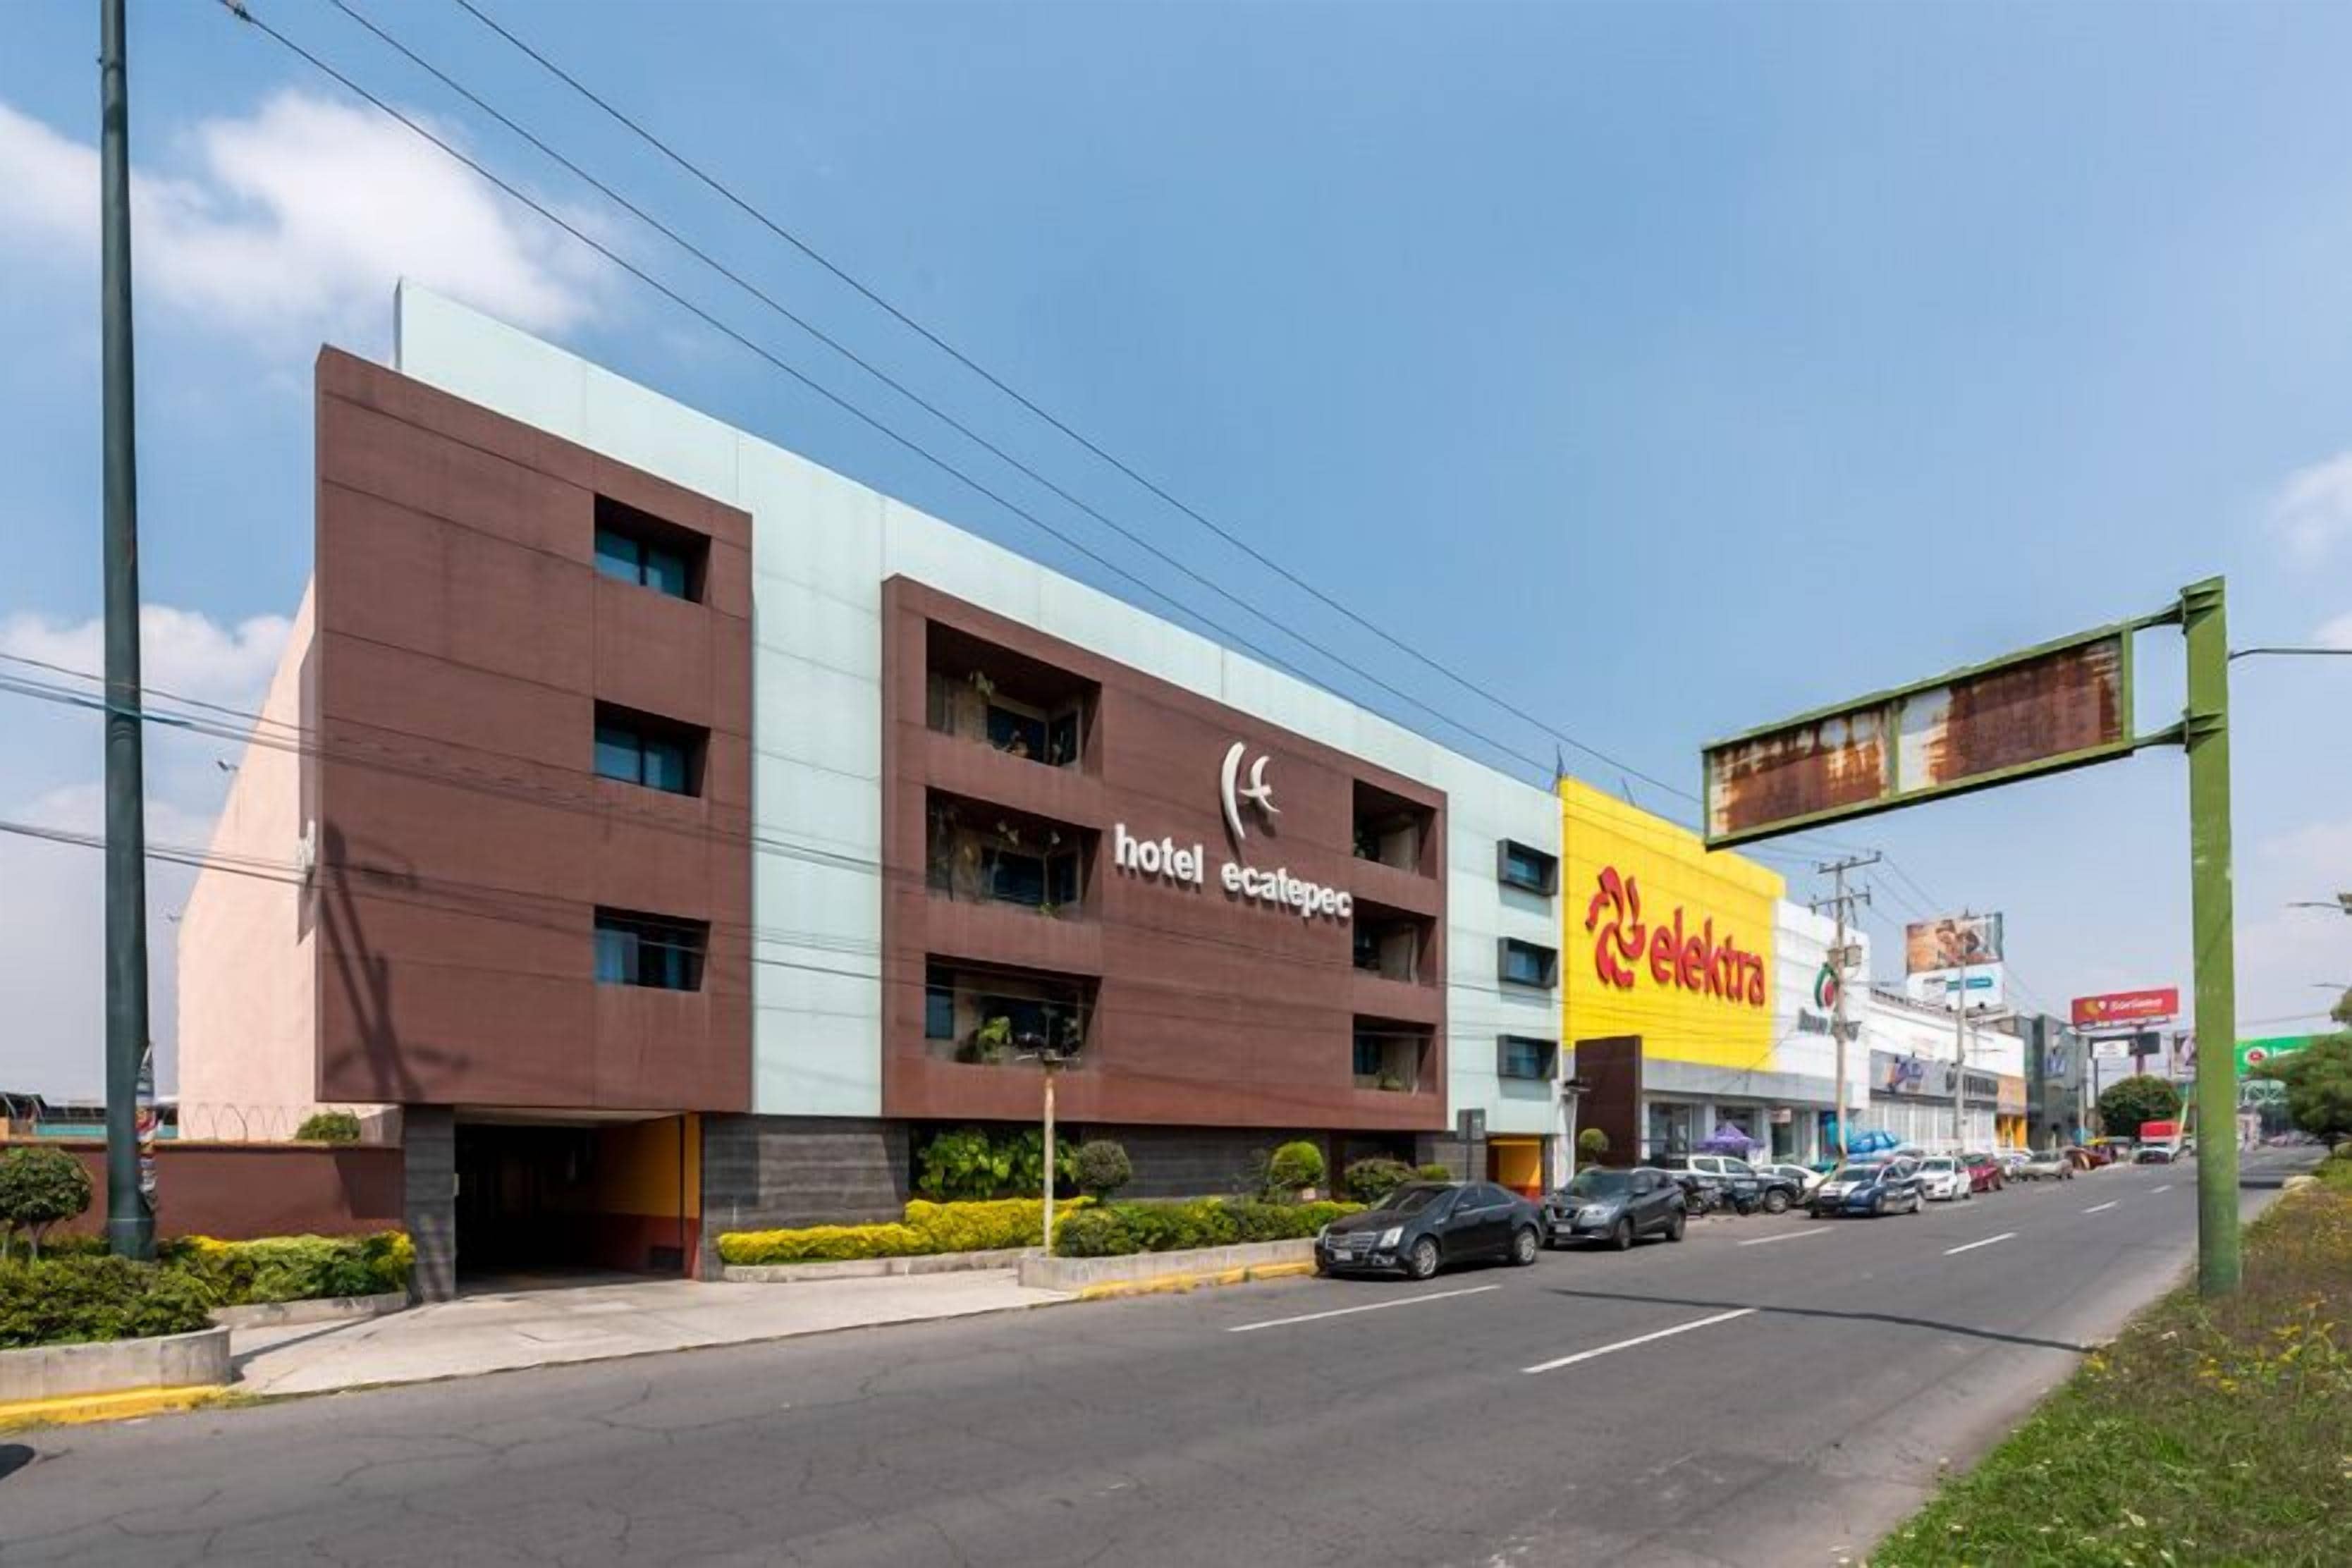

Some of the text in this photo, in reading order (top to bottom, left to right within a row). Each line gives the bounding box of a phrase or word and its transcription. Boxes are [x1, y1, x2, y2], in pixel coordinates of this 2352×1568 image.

[1114, 822, 1354, 918] hotel ecatepec
[1648, 905, 1765, 1007] elektra
